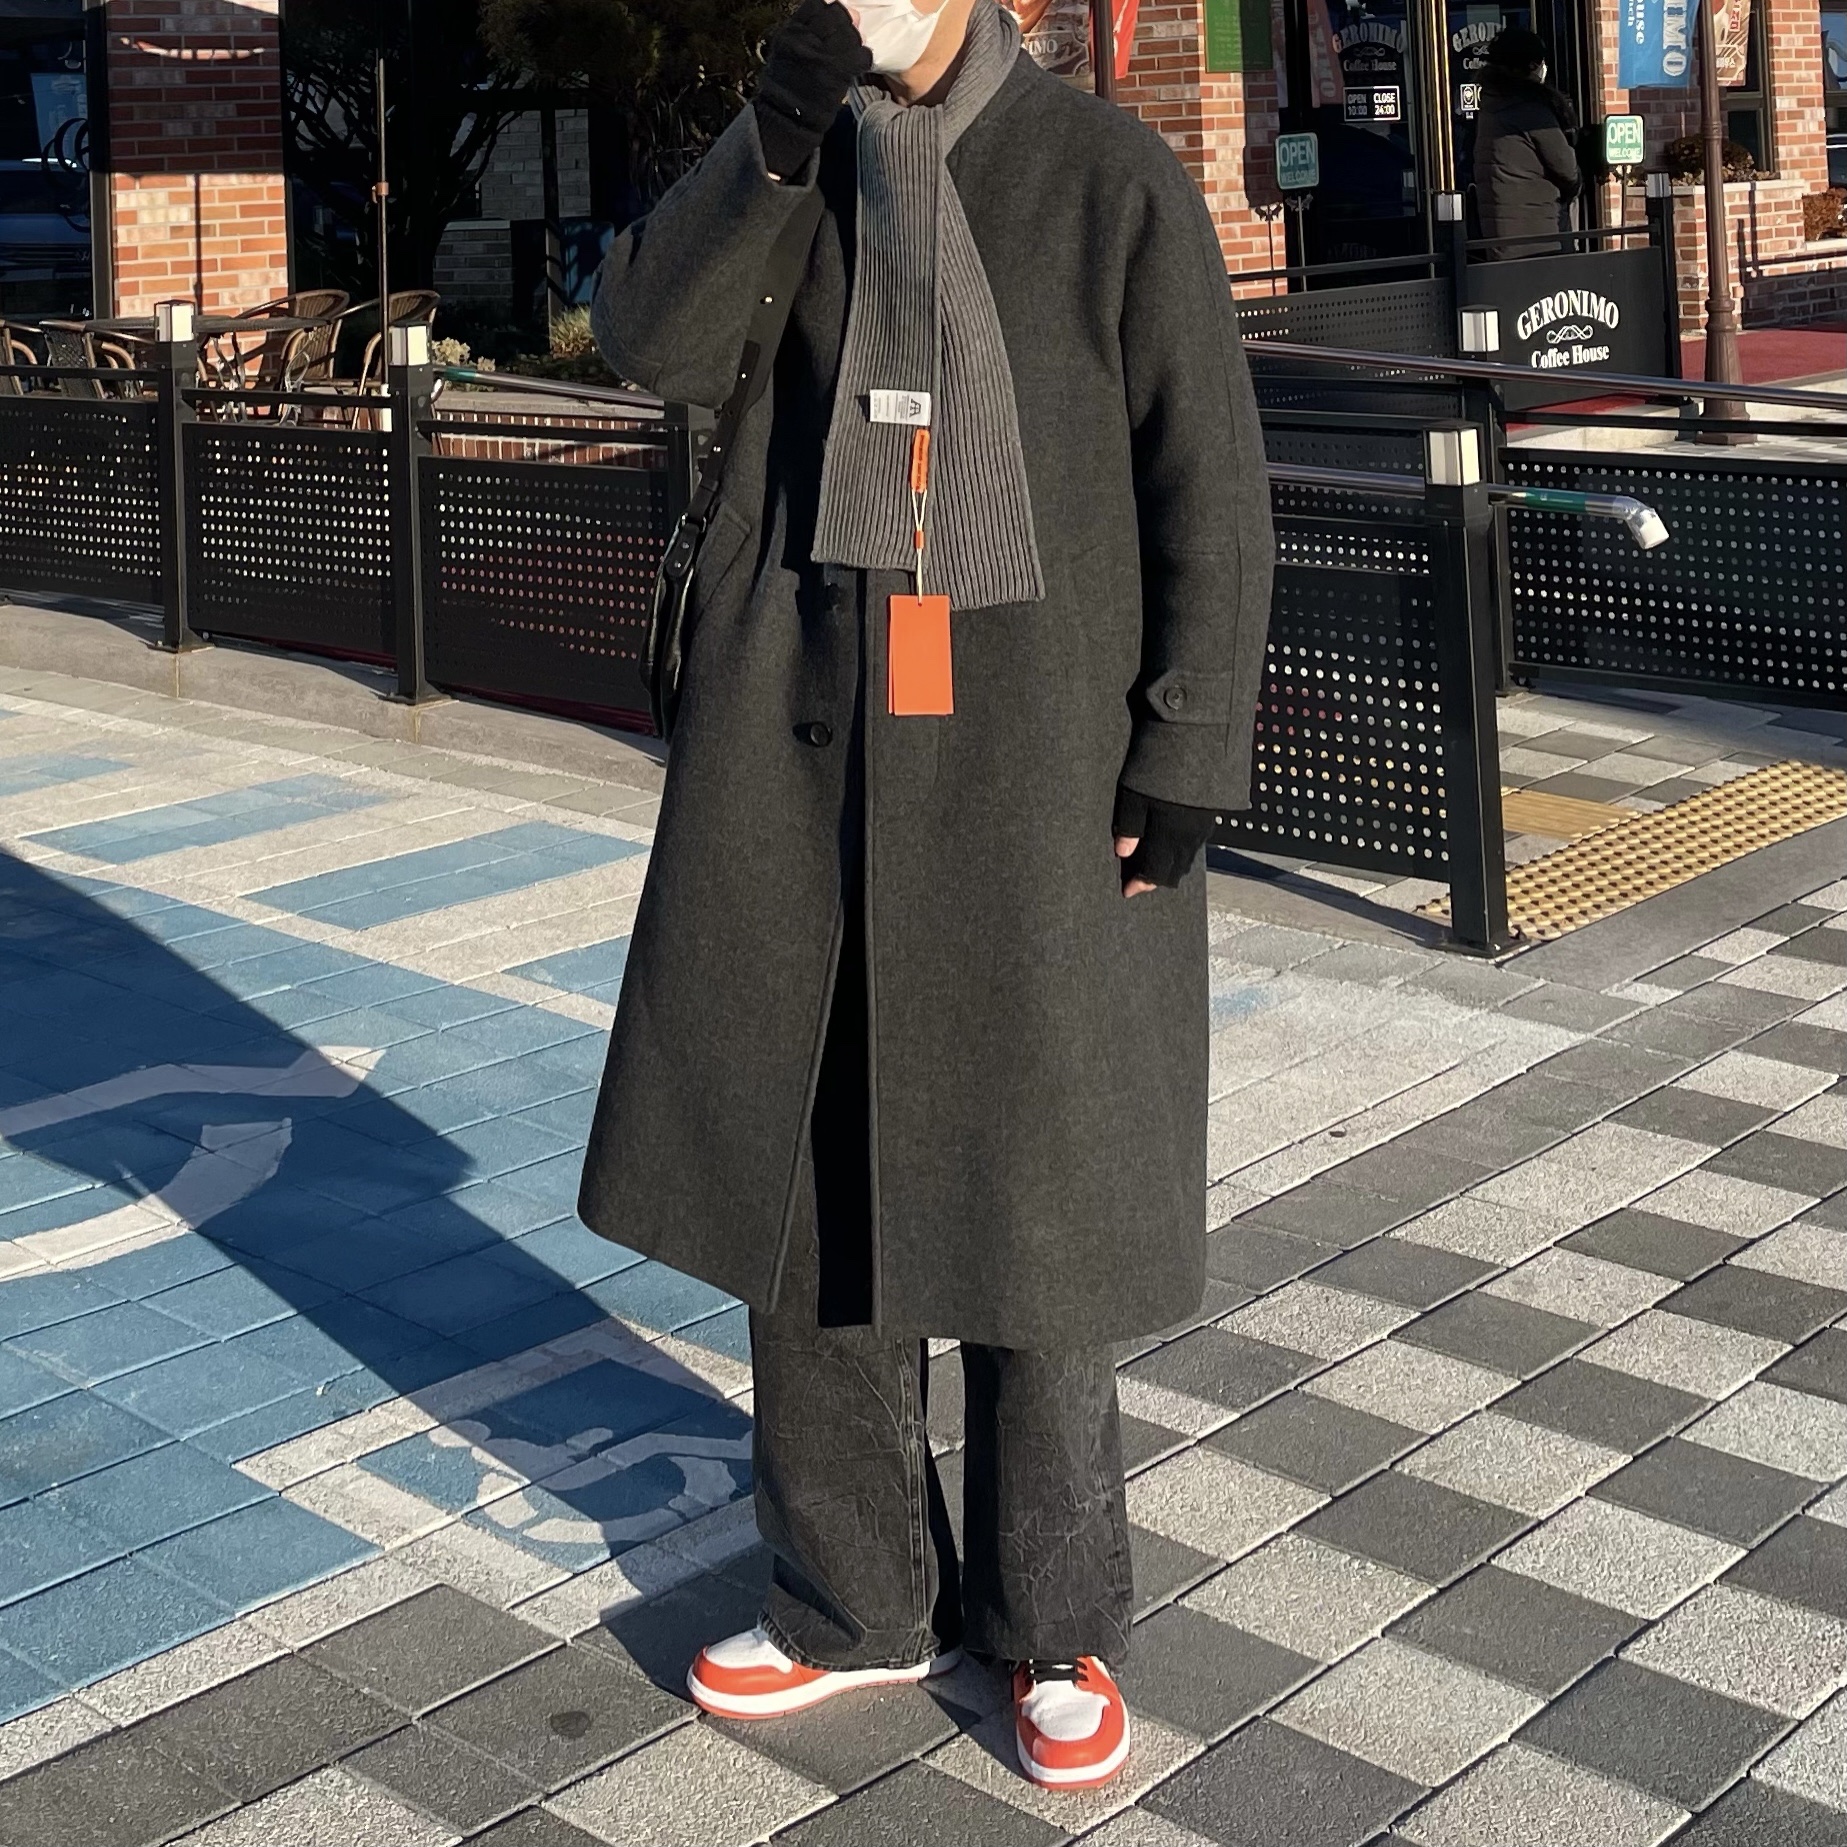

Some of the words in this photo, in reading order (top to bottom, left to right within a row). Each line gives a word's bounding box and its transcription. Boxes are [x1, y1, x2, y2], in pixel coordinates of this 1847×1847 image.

[1332, 22, 1405, 53] GERONIMO
[1343, 59, 1369, 71] Coffee
[1372, 60, 1397, 71] House
[1347, 94, 1367, 104] OPEN
[1373, 93, 1396, 103] CLOSE
[1374, 105, 1395, 115] 24:00
[1608, 122, 1641, 144] OPEN
[1280, 140, 1315, 167] OPEN
[1609, 148, 1641, 159] WELCOME
[1281, 169, 1316, 183] WELCOME
[1517, 289, 1619, 340] GERONIMO
[1531, 347, 1570, 369] Coffee
[1572, 344, 1610, 365] House
